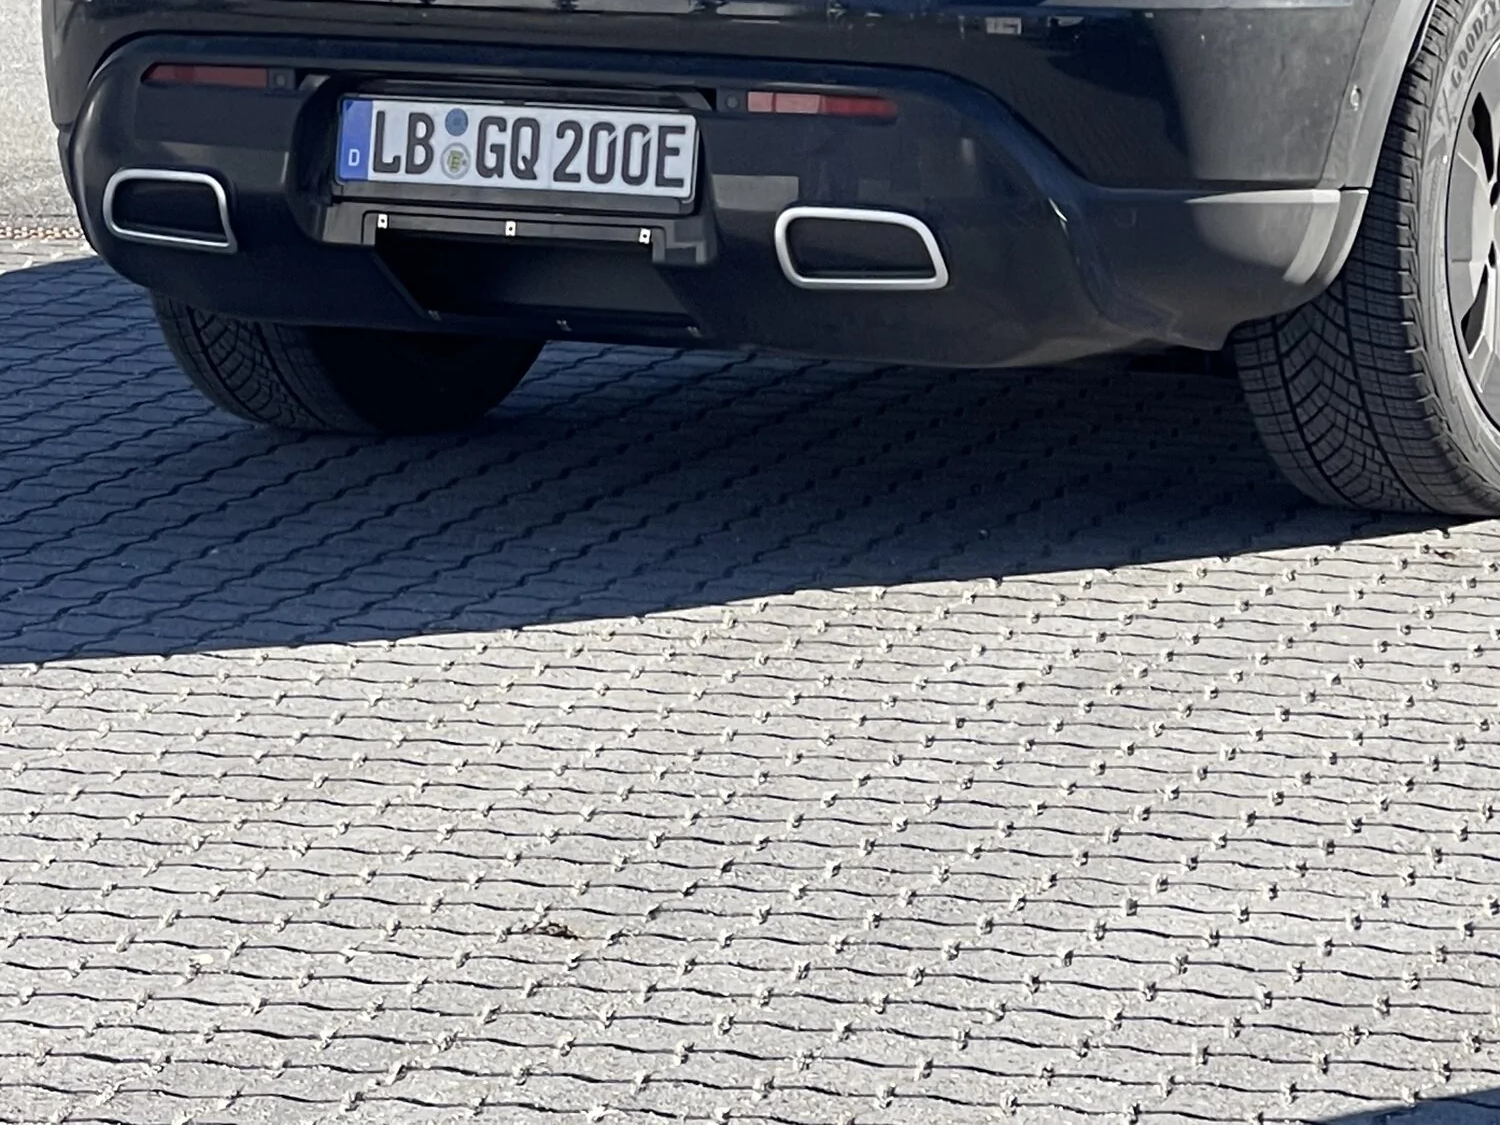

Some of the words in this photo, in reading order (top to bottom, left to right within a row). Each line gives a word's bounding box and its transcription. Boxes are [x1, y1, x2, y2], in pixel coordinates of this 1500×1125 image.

[348, 149, 360, 166] D
[372, 110, 435, 175] LB
[475, 115, 541, 181] GQ
[553, 119, 687, 188] 200E
